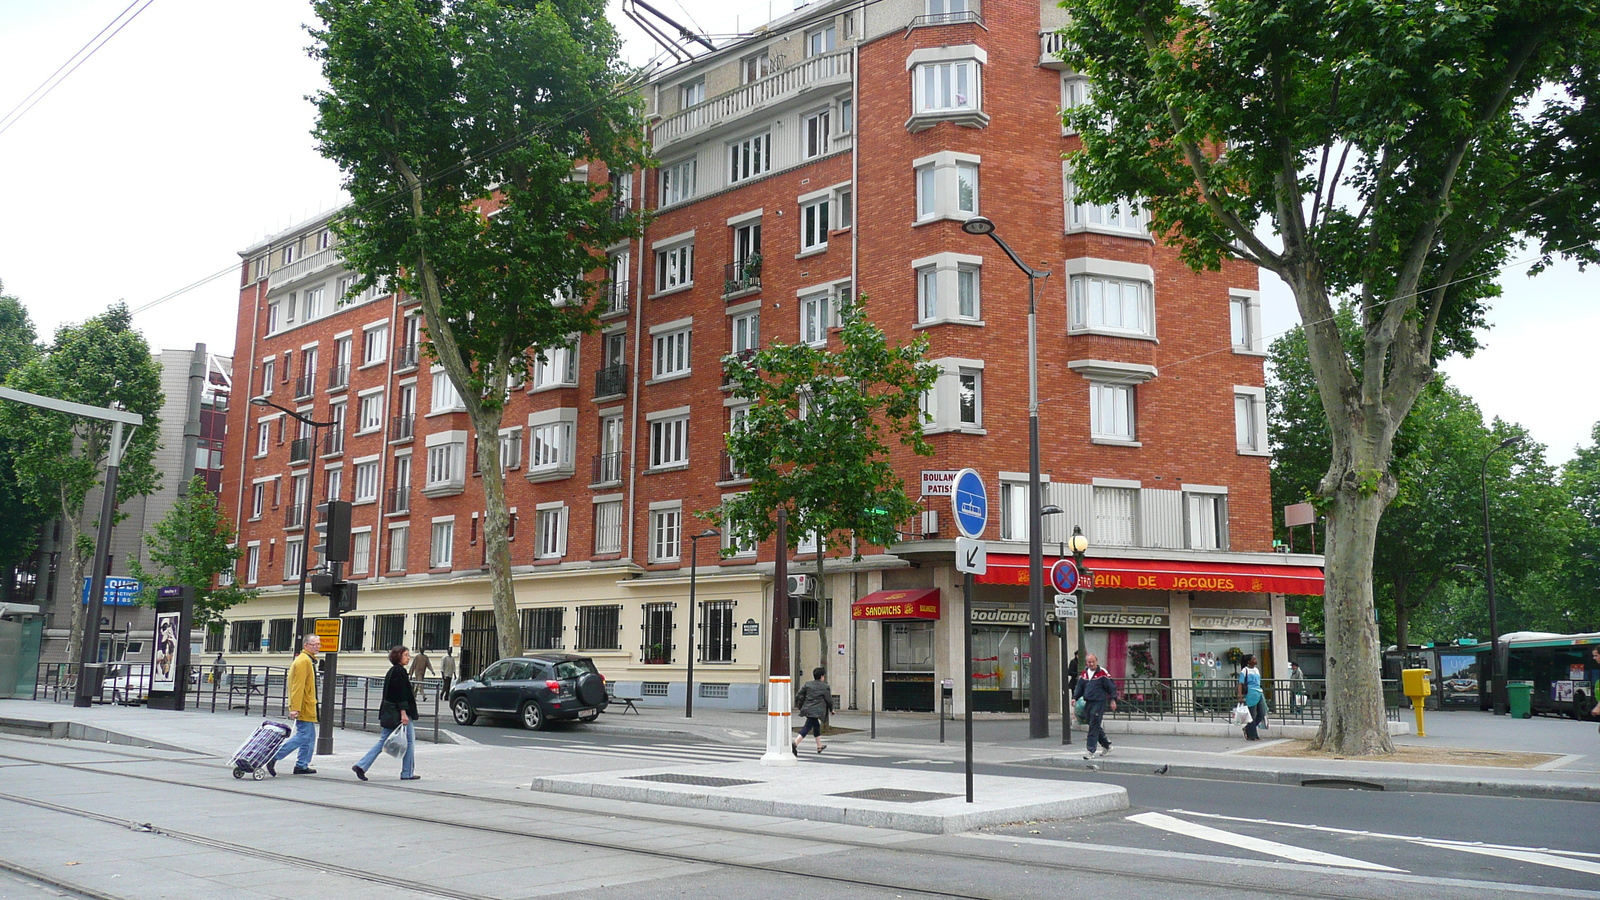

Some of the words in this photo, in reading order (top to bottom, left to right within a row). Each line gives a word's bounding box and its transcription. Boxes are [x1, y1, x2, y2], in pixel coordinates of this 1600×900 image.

[1094, 574, 1121, 586] AIN
[1138, 575, 1157, 587] DE
[1172, 576, 1235, 590] JACQUES
[865, 605, 902, 616] SANDWICHS
[971, 610, 1055, 622] boulangie
[1090, 613, 1162, 625] patisserie
[1200, 617, 1265, 627] confiserie
